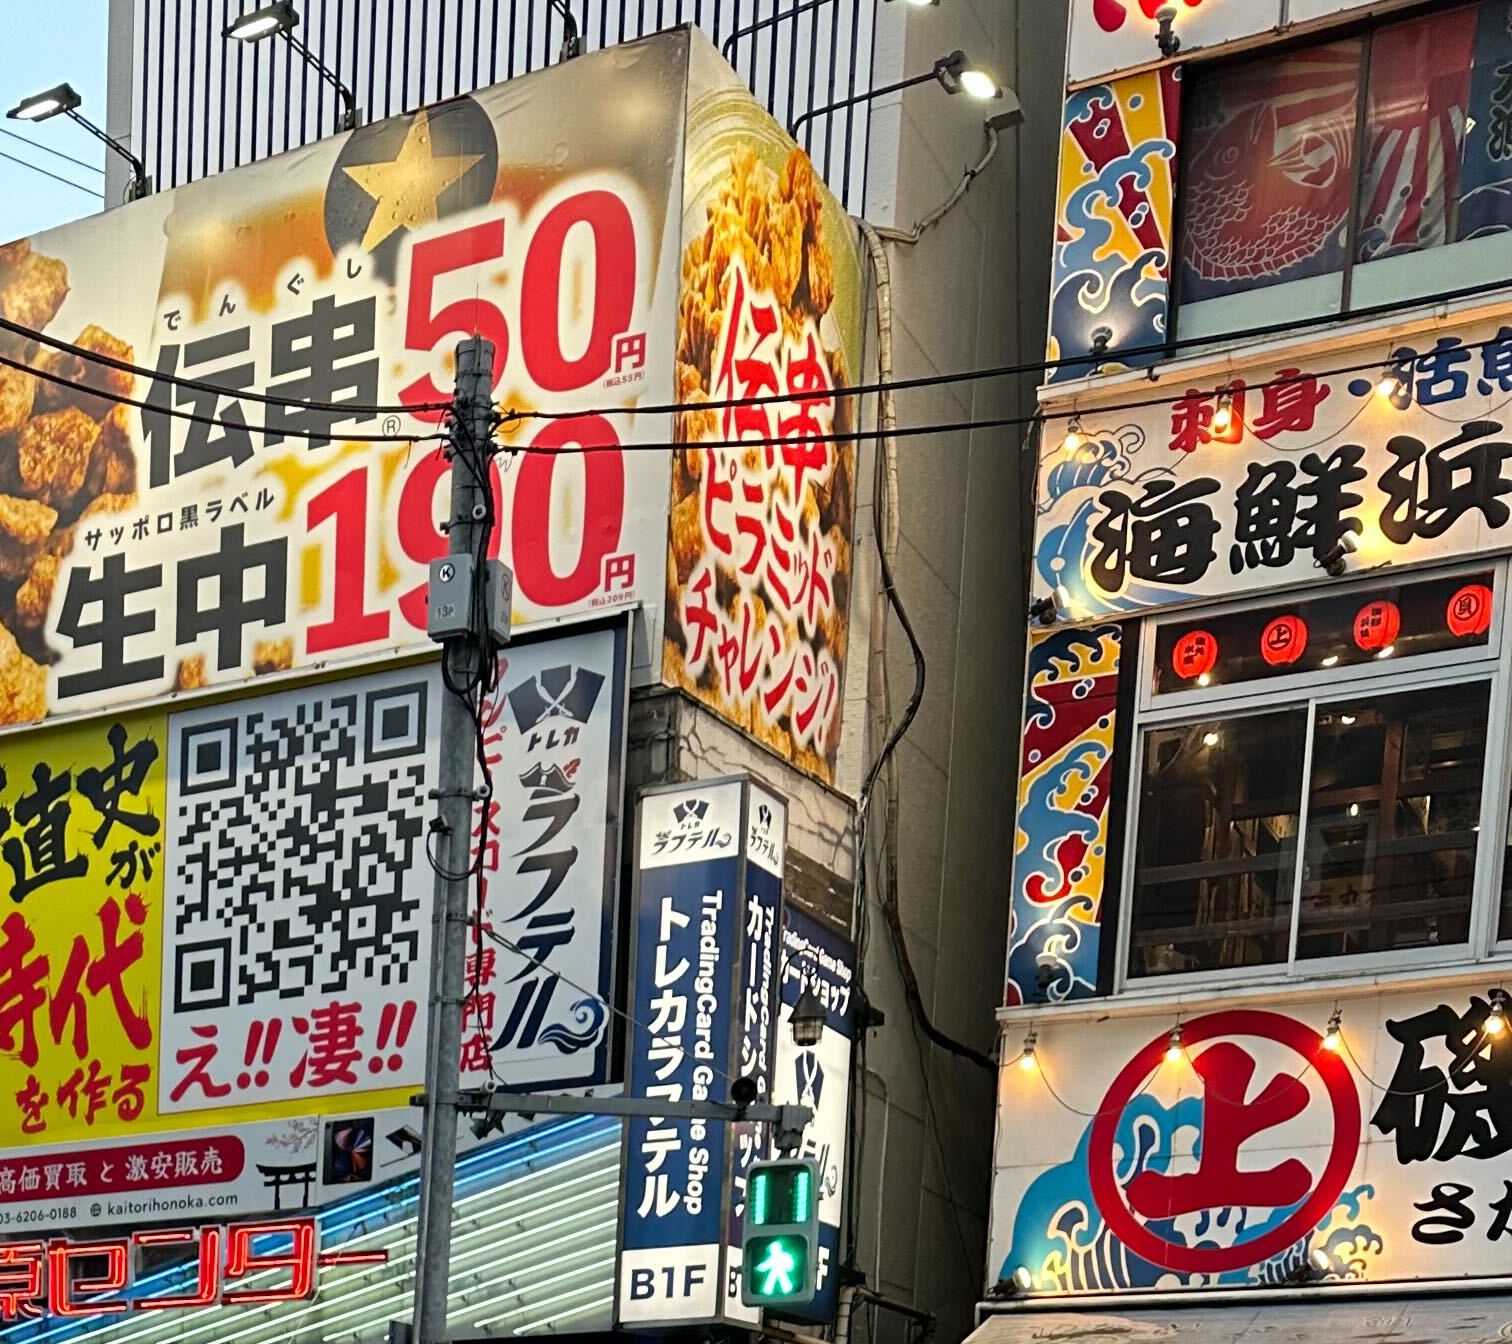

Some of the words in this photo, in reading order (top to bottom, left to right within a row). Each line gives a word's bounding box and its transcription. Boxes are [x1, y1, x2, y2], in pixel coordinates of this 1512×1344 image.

[164, 257, 363, 331] でんぐし
[141, 293, 380, 488] 伝串
[716, 264, 833, 500] 伝串
[84, 487, 275, 551] サッポロ黒ラベル
[703, 447, 834, 625] ピラミッド
[56, 522, 288, 701] 生中
[527, 726, 579, 753] トレカ
[16, 1060, 153, 1135] を作る
[689, 1065, 714, 1141] Gae
[99, 1160, 115, 1184] と
[124, 1145, 224, 1183] 激安販売
[686, 1147, 710, 1216] Shop
[107, 1193, 239, 1217] kaitorihonoka.com
[630, 1263, 706, 1301] B1F
